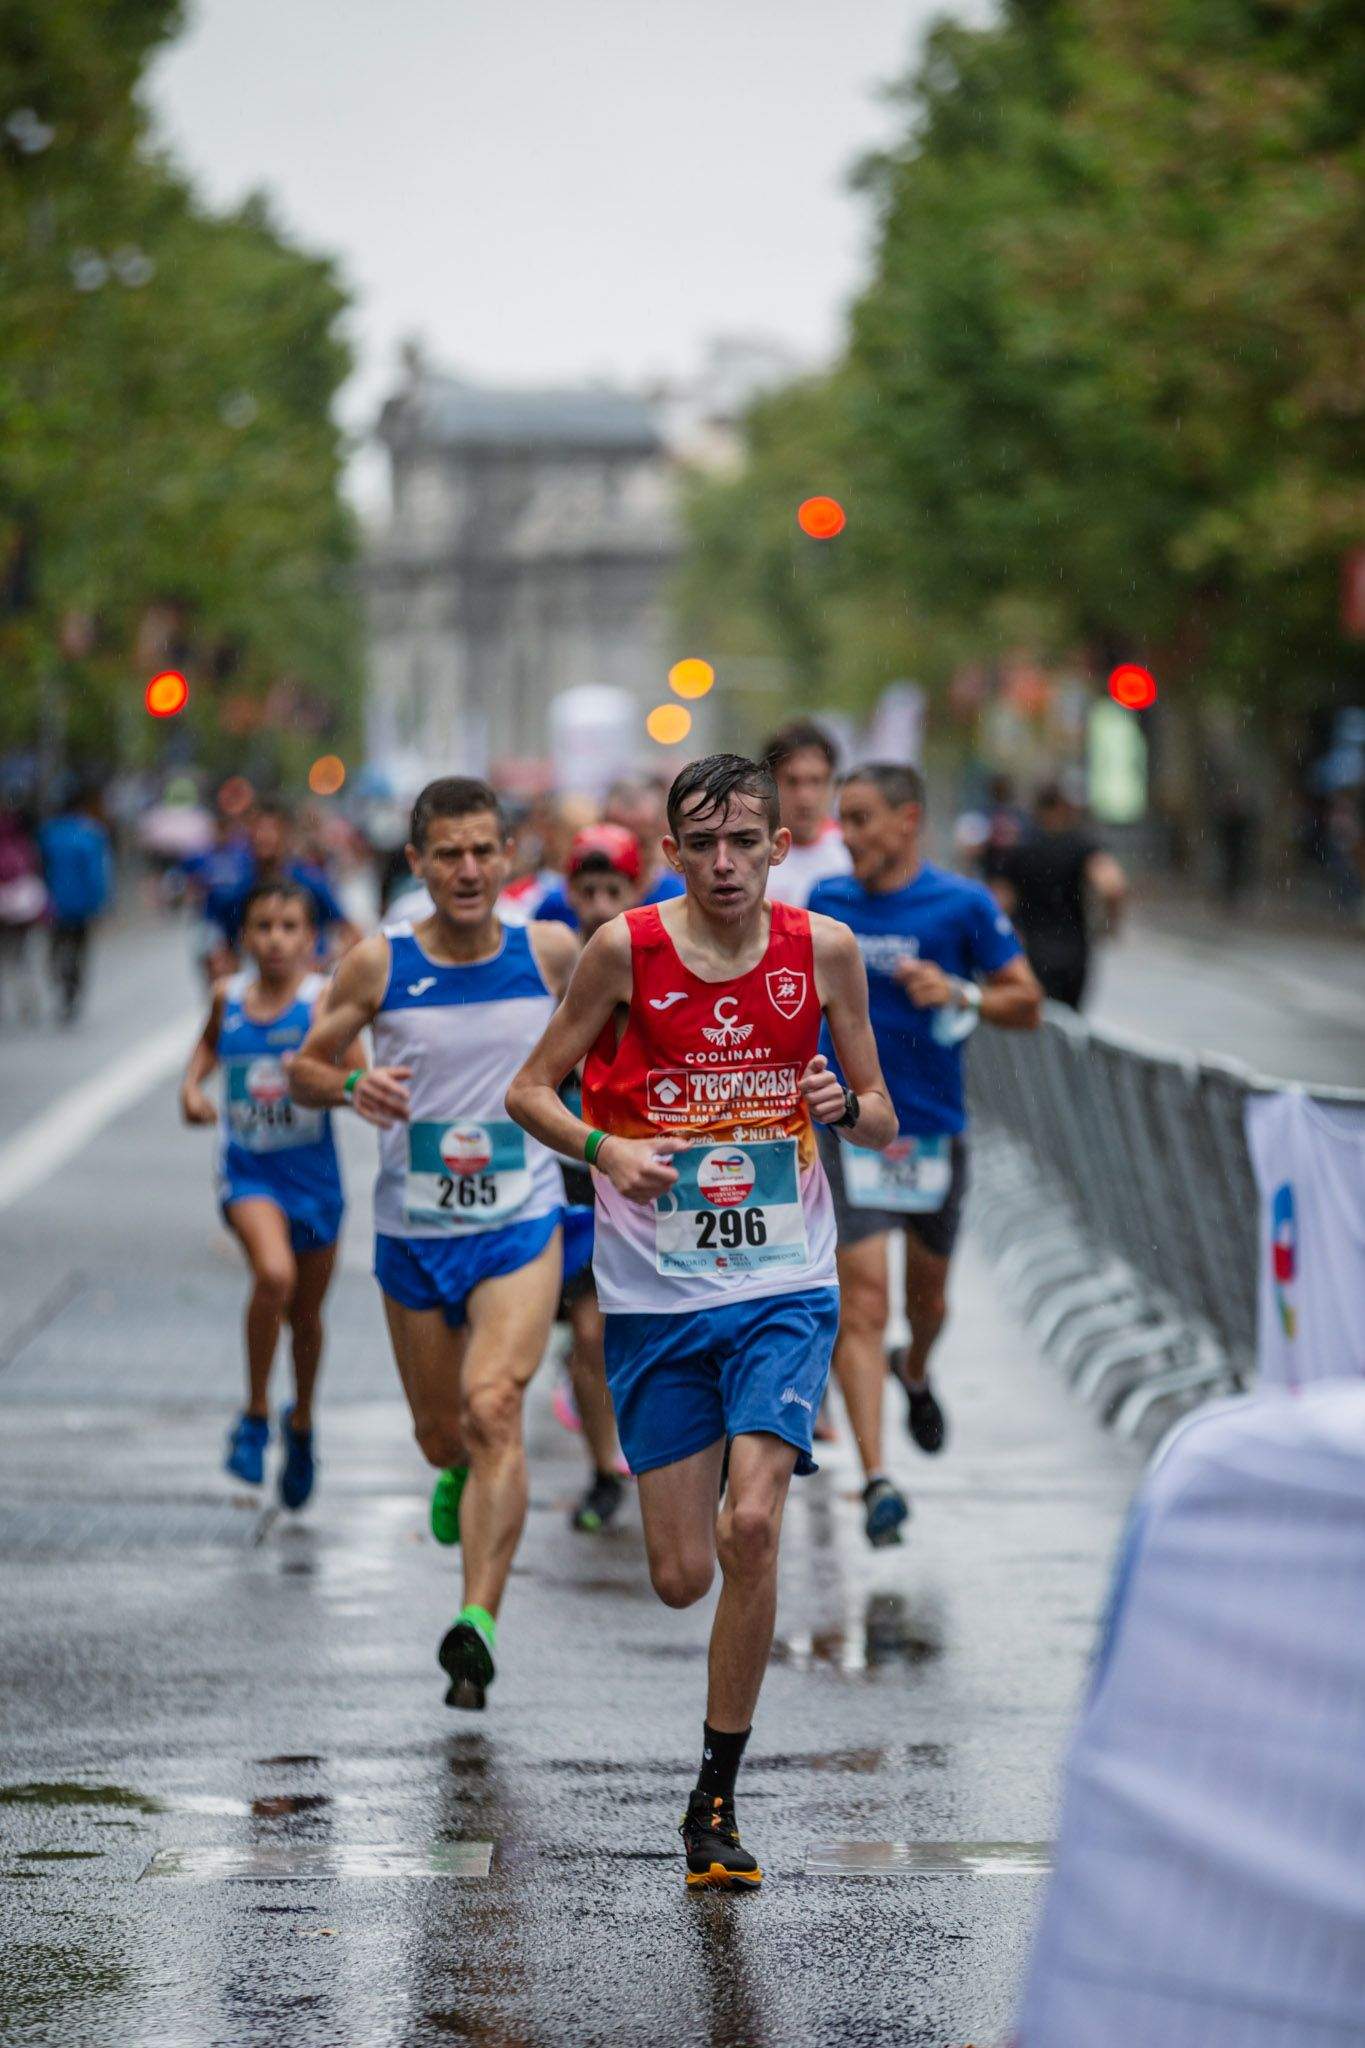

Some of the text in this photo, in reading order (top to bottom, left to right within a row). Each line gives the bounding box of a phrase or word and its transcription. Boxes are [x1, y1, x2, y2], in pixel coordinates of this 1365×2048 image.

[685, 1047, 771, 1064] COOLINARY
[648, 1111, 688, 1123] ESTUDIO
[690, 1114, 709, 1123] SAN
[438, 1176, 497, 1210] 265
[695, 1207, 767, 1250] 296
